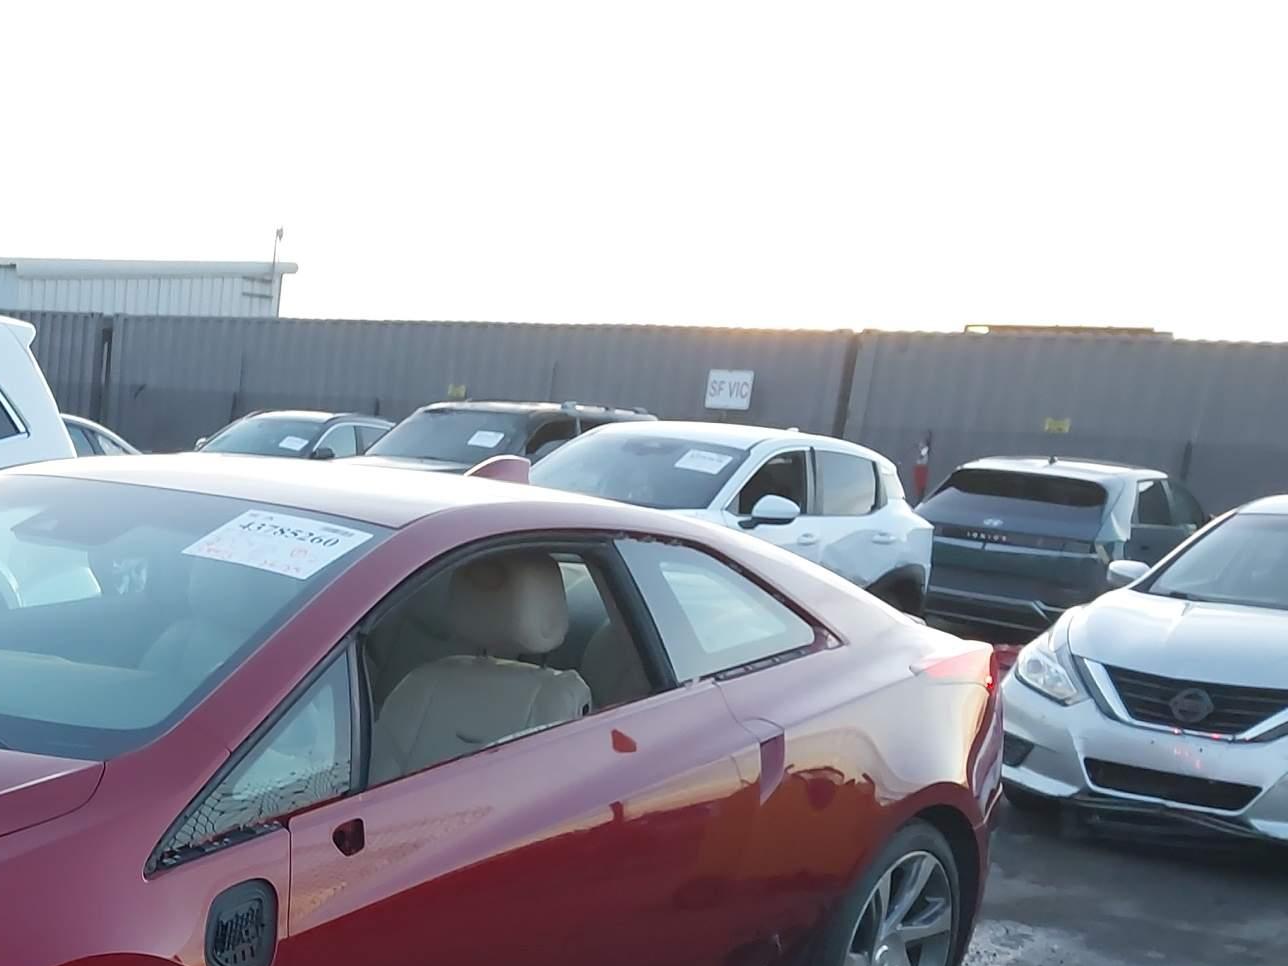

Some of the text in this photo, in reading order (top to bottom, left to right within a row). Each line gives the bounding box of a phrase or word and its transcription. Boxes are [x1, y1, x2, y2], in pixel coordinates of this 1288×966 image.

[708, 379, 750, 399] SF VIC
[239, 520, 340, 548] 43785260
